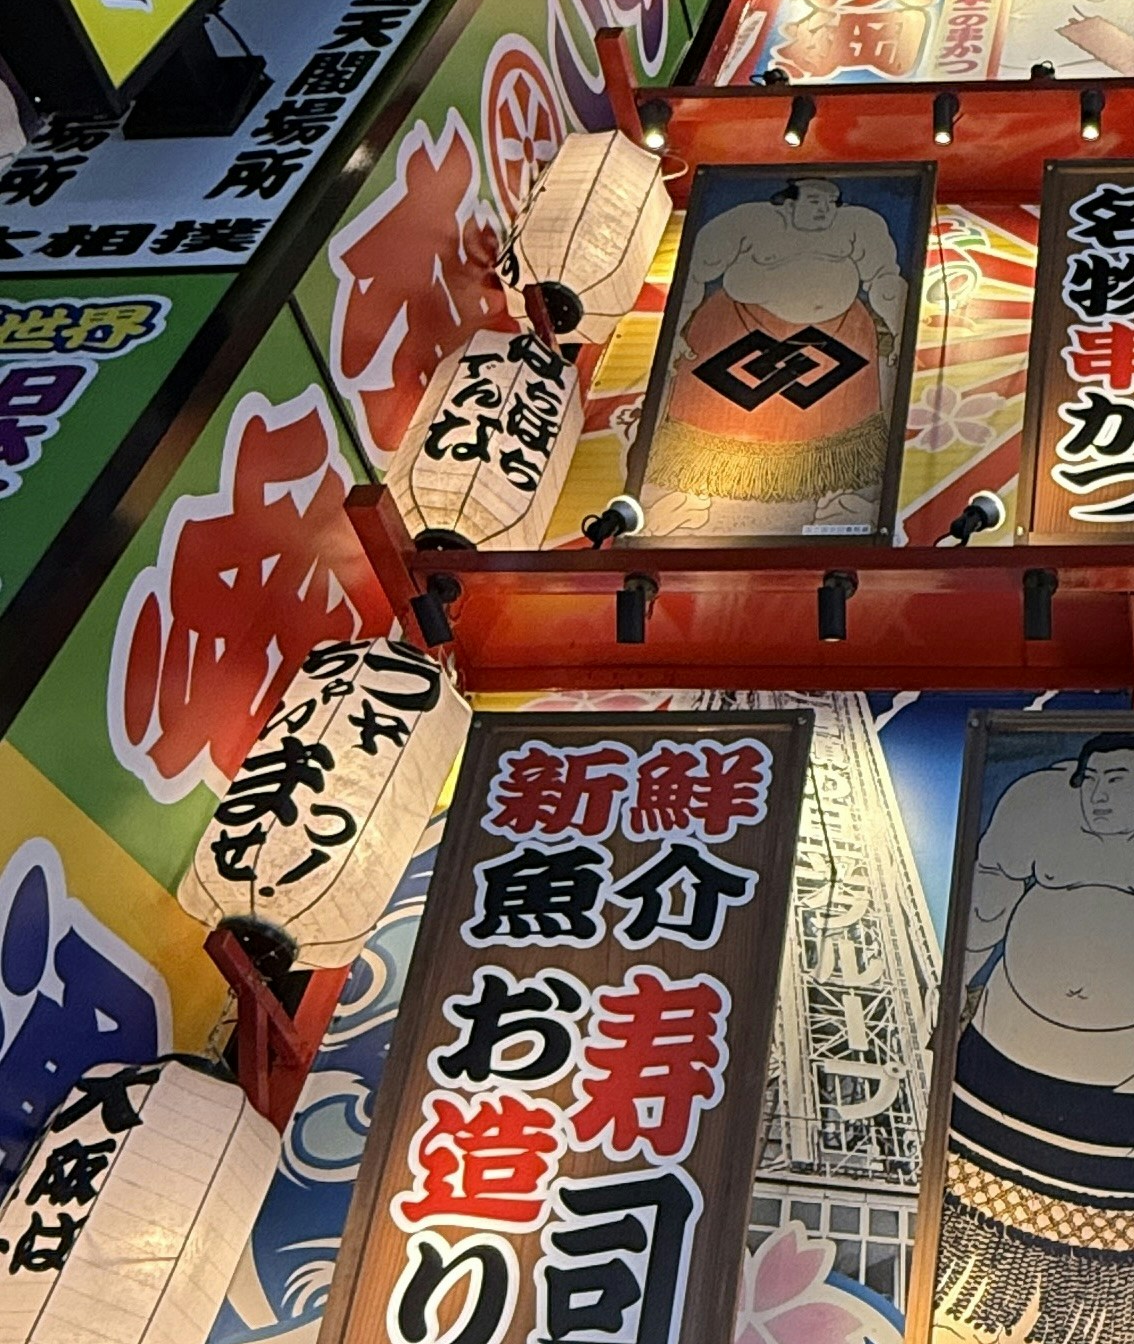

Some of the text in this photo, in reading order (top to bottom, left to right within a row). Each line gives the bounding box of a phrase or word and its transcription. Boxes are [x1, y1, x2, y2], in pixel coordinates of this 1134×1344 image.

[0, 299, 162, 354] 世界
[490, 742, 768, 838] 新鮮
[472, 844, 750, 942] 魚介
[8, 1065, 161, 1276] 大阪は
